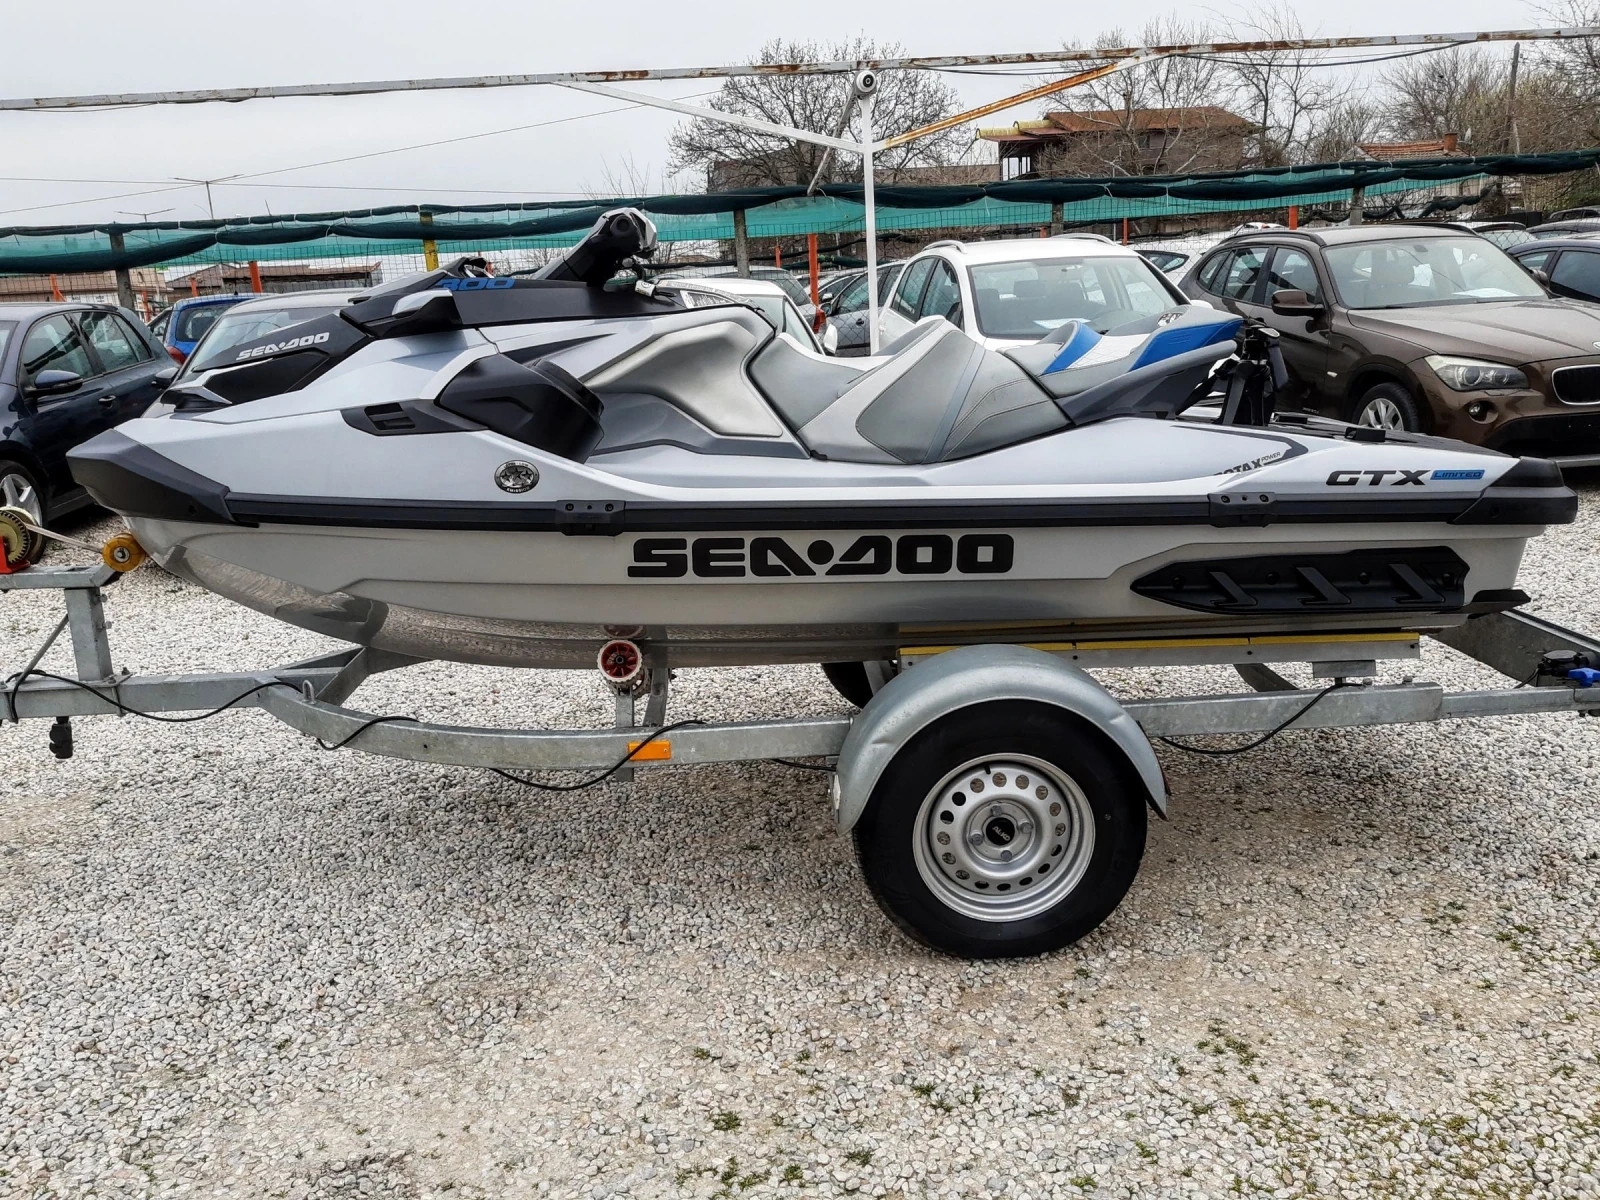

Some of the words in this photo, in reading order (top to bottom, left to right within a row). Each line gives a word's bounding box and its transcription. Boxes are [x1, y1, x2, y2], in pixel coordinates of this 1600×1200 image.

[1261, 452, 1281, 462] POWER
[1326, 470, 1431, 486] GTX
[1433, 470, 1483, 479] LIMITED
